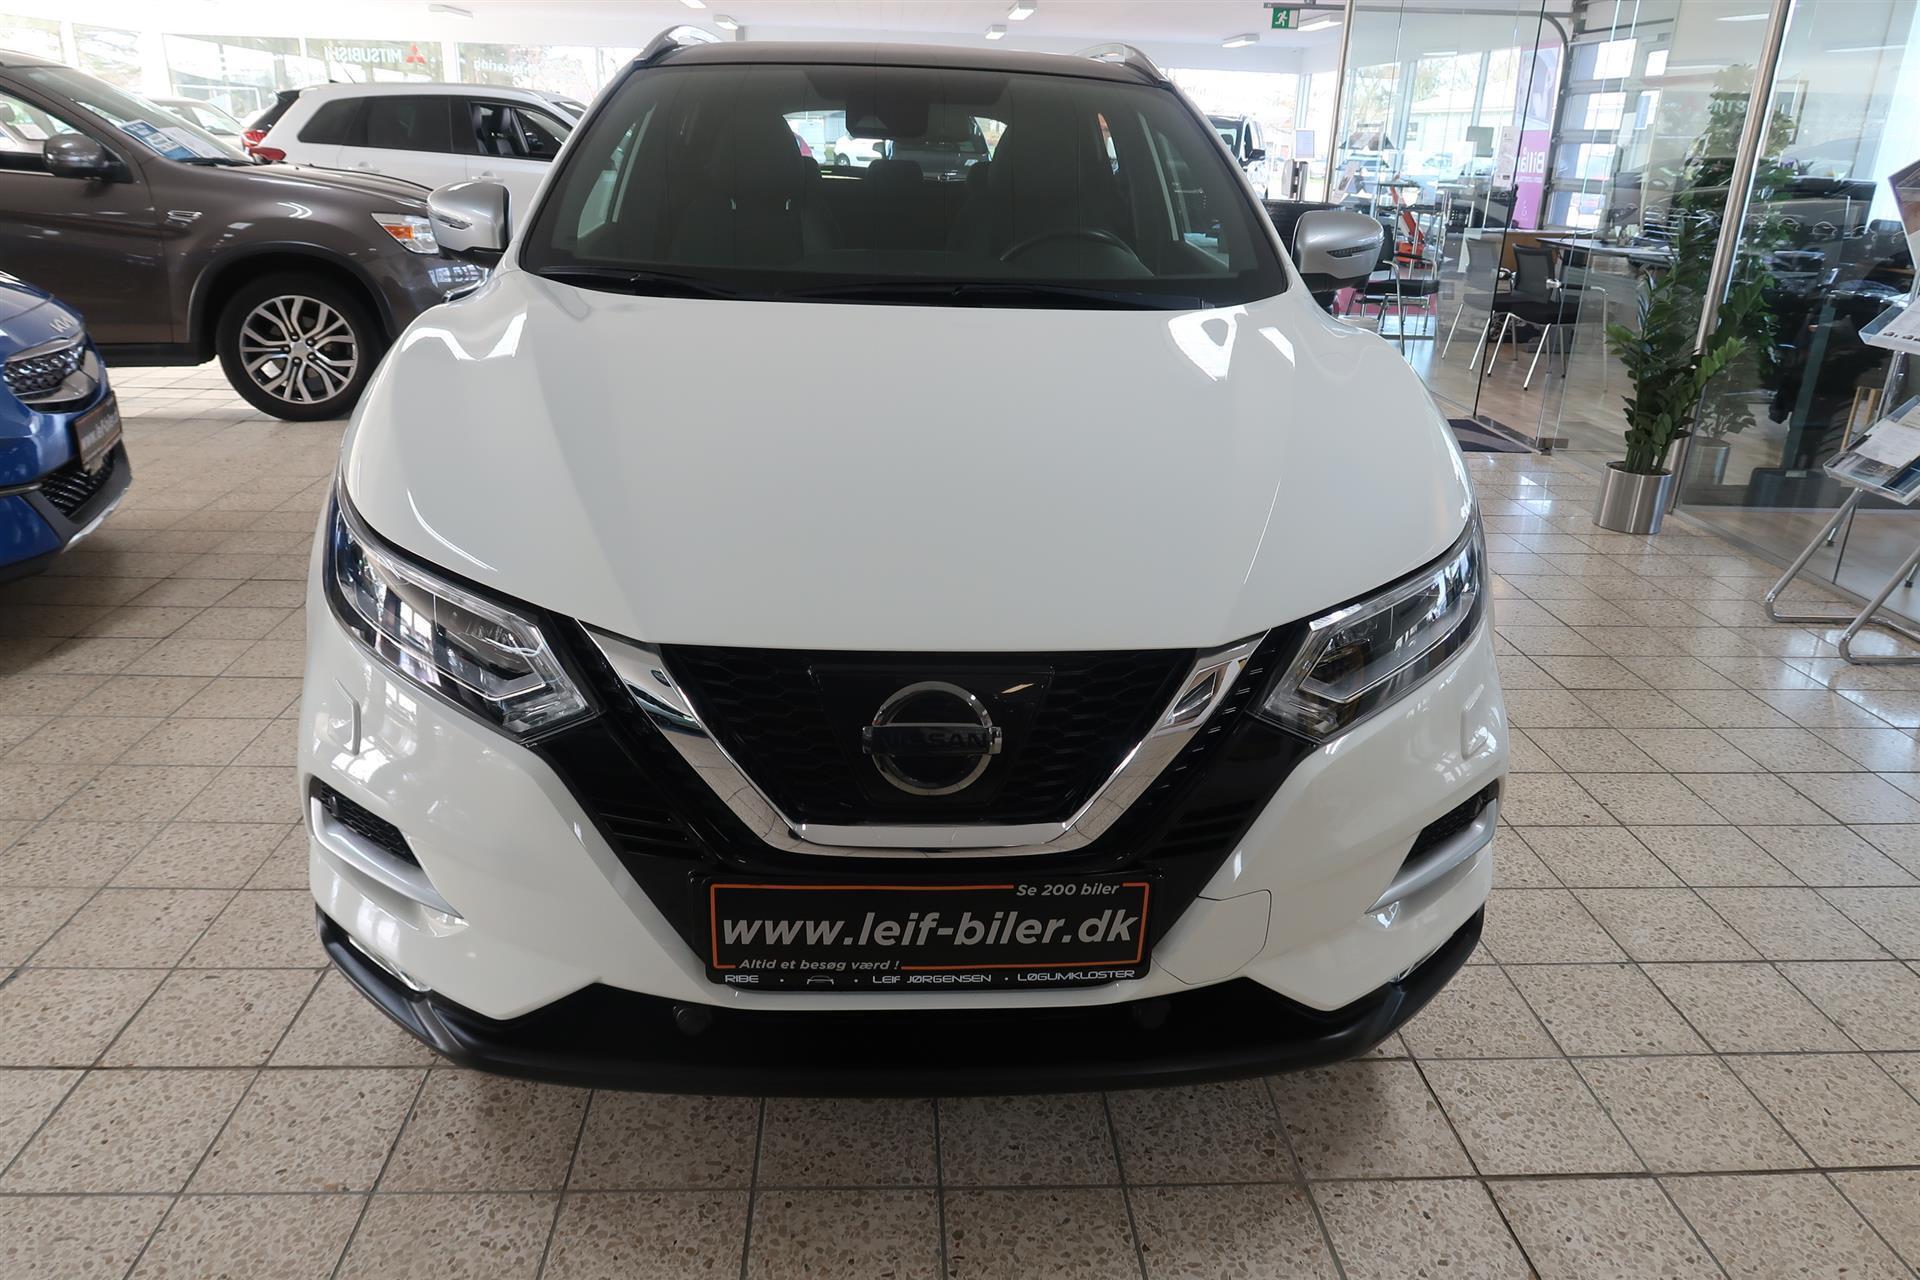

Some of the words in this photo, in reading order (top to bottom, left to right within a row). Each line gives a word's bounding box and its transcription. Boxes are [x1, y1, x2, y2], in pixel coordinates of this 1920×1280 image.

[879, 731, 987, 748] NISSAN
[1016, 884, 1037, 896] Se
[1041, 883, 1076, 896] 200
[1081, 882, 1120, 895] biler
[723, 909, 1138, 946] www.leif-biler.dk
[739, 959, 777, 969] Altid
[780, 960, 795, 969] et
[800, 959, 846, 972] besøg
[851, 960, 891, 970] værd
[725, 974, 759, 983] RIBE
[872, 975, 901, 983] LEIF
[907, 974, 992, 984] JØRGENSEN
[1017, 969, 1136, 982] LØGUMKLOSTER
